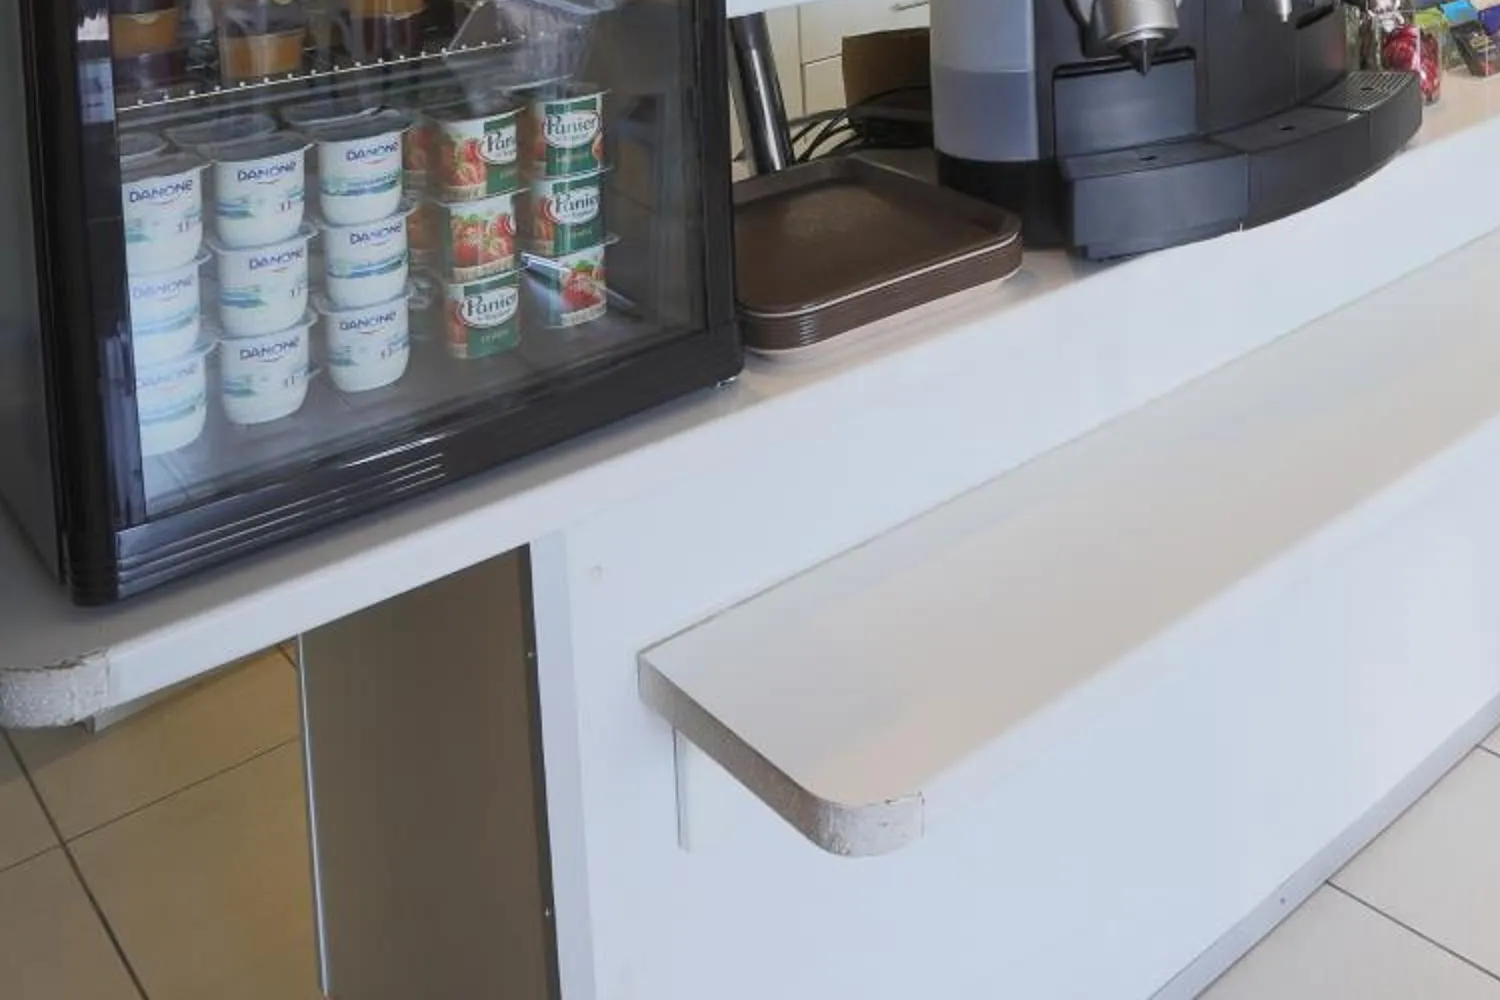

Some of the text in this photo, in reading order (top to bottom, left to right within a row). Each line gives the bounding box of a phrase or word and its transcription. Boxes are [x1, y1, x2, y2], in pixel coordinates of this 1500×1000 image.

[546, 115, 597, 137] Panier
[345, 141, 399, 161] DANONE
[237, 161, 297, 182] DANONE
[129, 179, 194, 203] DANONE
[555, 193, 597, 215] Panie
[349, 222, 402, 244] DANONE
[339, 311, 397, 331] DANONE
[239, 337, 300, 361] DANONE
